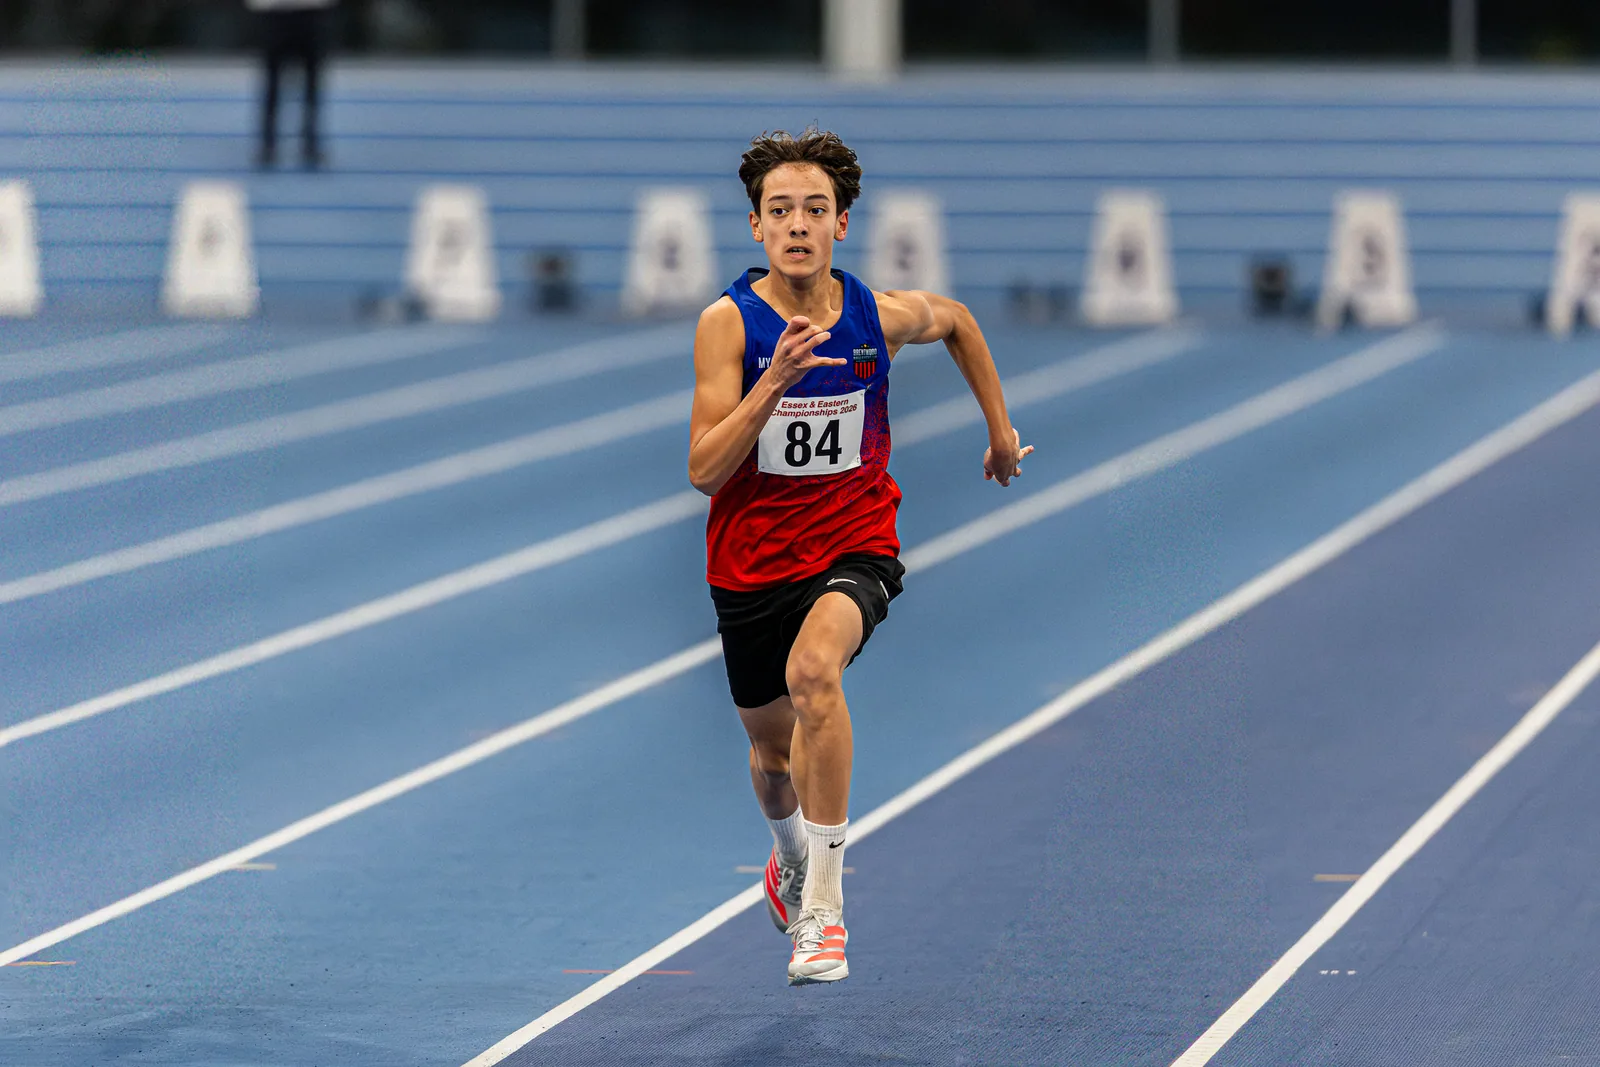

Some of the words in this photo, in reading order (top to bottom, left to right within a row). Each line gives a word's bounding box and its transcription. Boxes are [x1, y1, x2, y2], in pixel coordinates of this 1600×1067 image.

[770, 409, 838, 418] Championships
[839, 403, 857, 414] 2026
[781, 401, 808, 409] Essex
[817, 398, 849, 408] Eastern
[784, 419, 842, 467] 84
